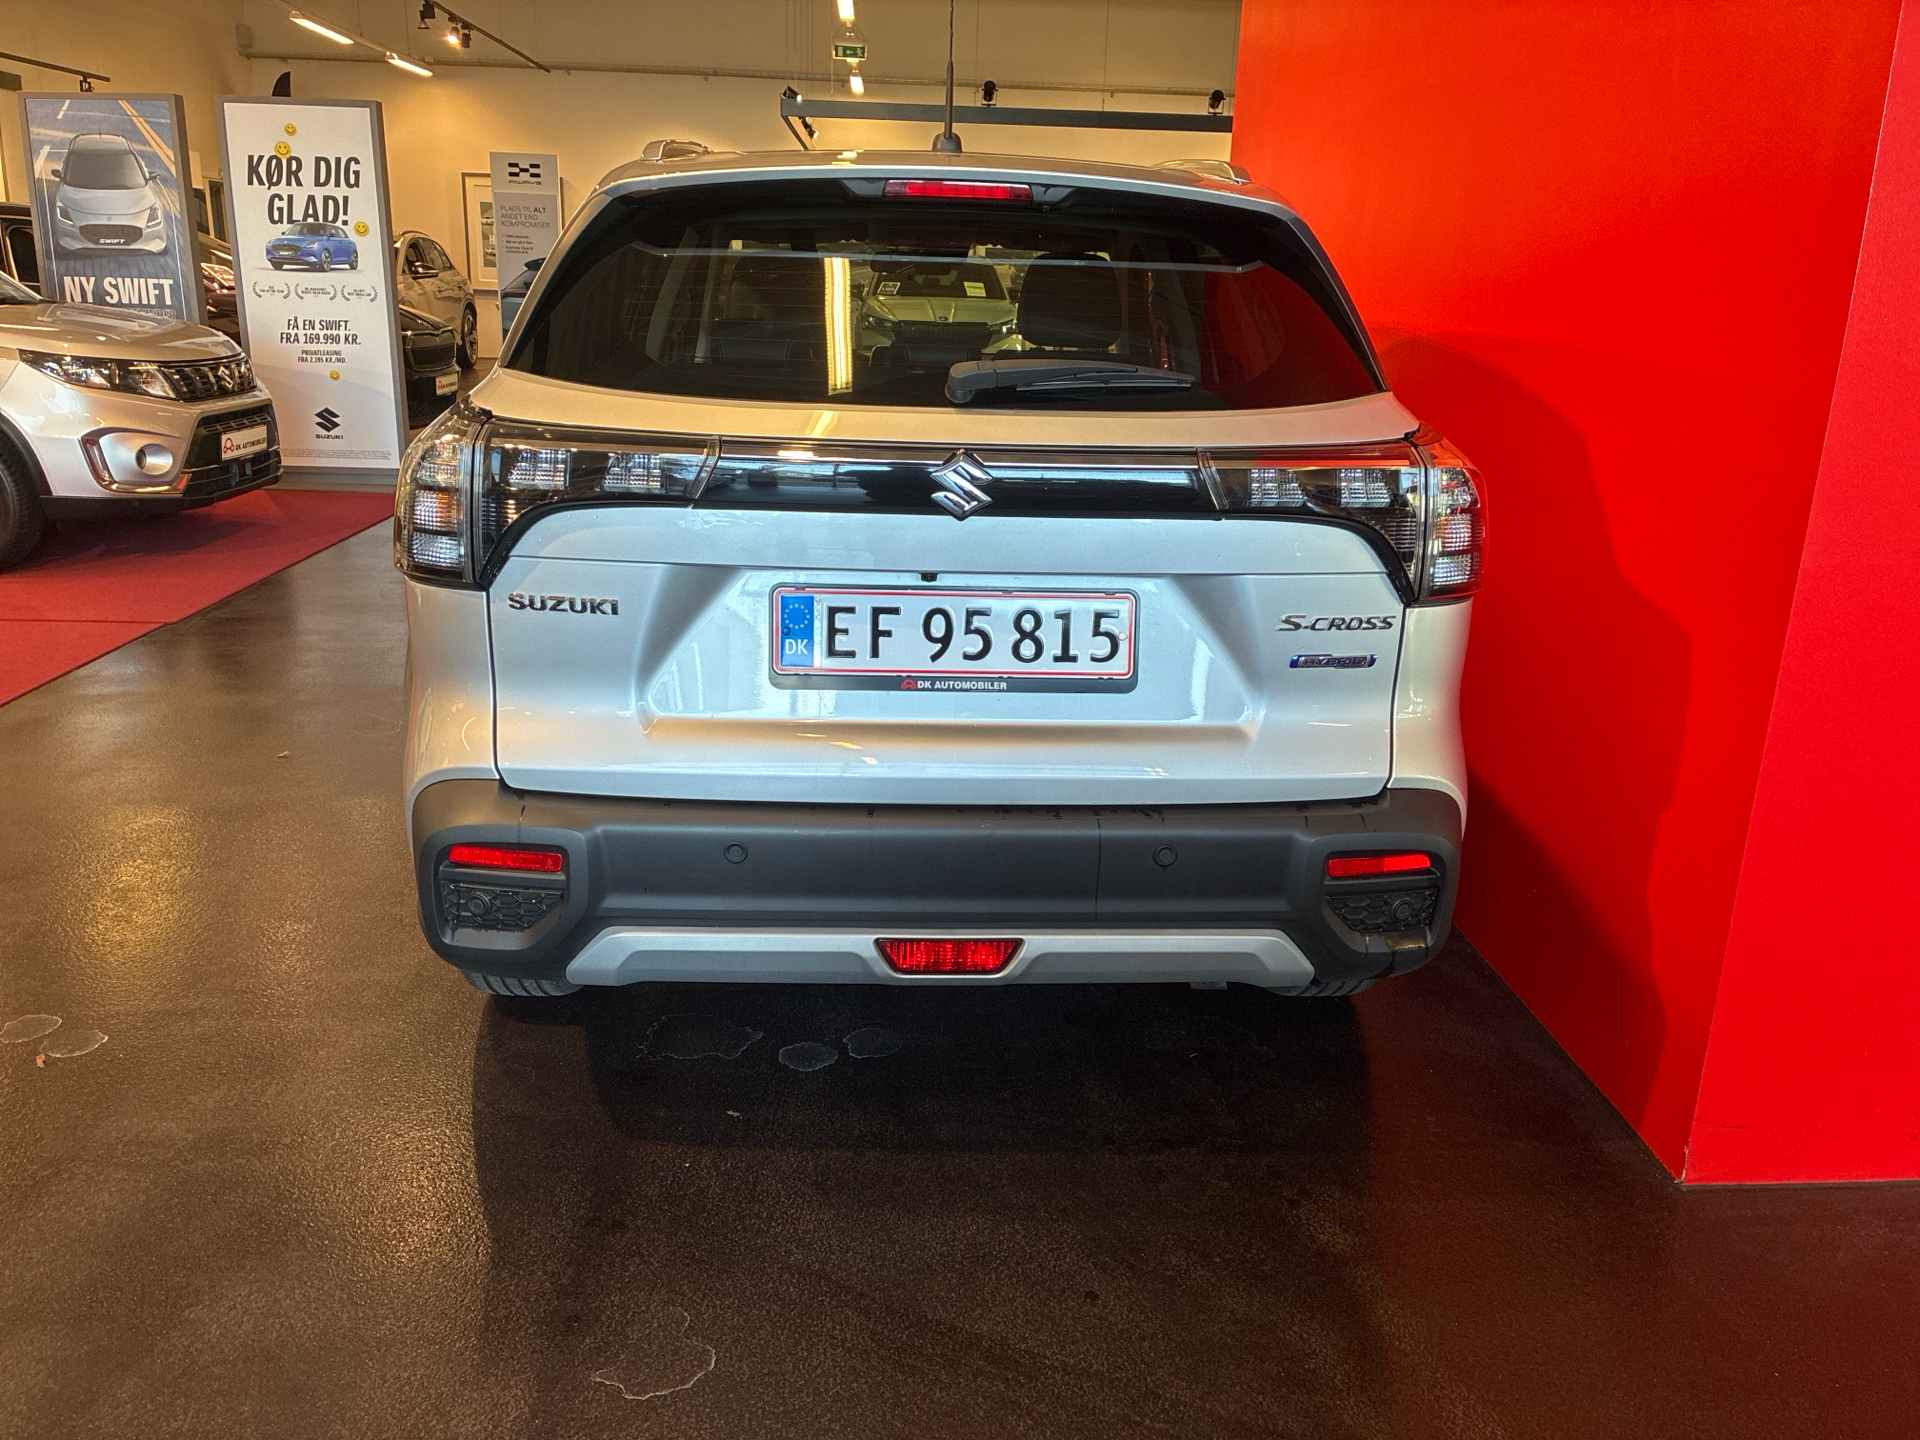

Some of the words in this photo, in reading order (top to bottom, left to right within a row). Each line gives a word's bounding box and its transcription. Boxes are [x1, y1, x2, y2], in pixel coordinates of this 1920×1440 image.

[247, 154, 303, 190] KØR
[313, 156, 361, 189] DIG
[267, 193, 349, 226] GLAD!
[500, 205, 521, 213] PLADS
[501, 220, 550, 229] KOMPROMISER
[524, 213, 538, 221] END
[63, 275, 95, 303] NY
[103, 276, 174, 306] SWIFT
[287, 316, 300, 331] FÅ
[303, 319, 316, 331] EN
[318, 319, 351, 332] SWIFT.
[280, 332, 300, 344] FRA
[303, 332, 341, 345] 169.990
[344, 333, 361, 346] KR.
[301, 349, 342, 357] PRIVATLEASING
[508, 592, 619, 616] SUZUKI
[826, 606, 902, 659] EF
[922, 606, 993, 663] 95
[1011, 608, 1120, 663] 815
[784, 639, 809, 655] DK
[1301, 656, 1367, 668] HYBRID
[917, 680, 932, 690] DK
[934, 680, 1007, 690] AUTOMOBILER
